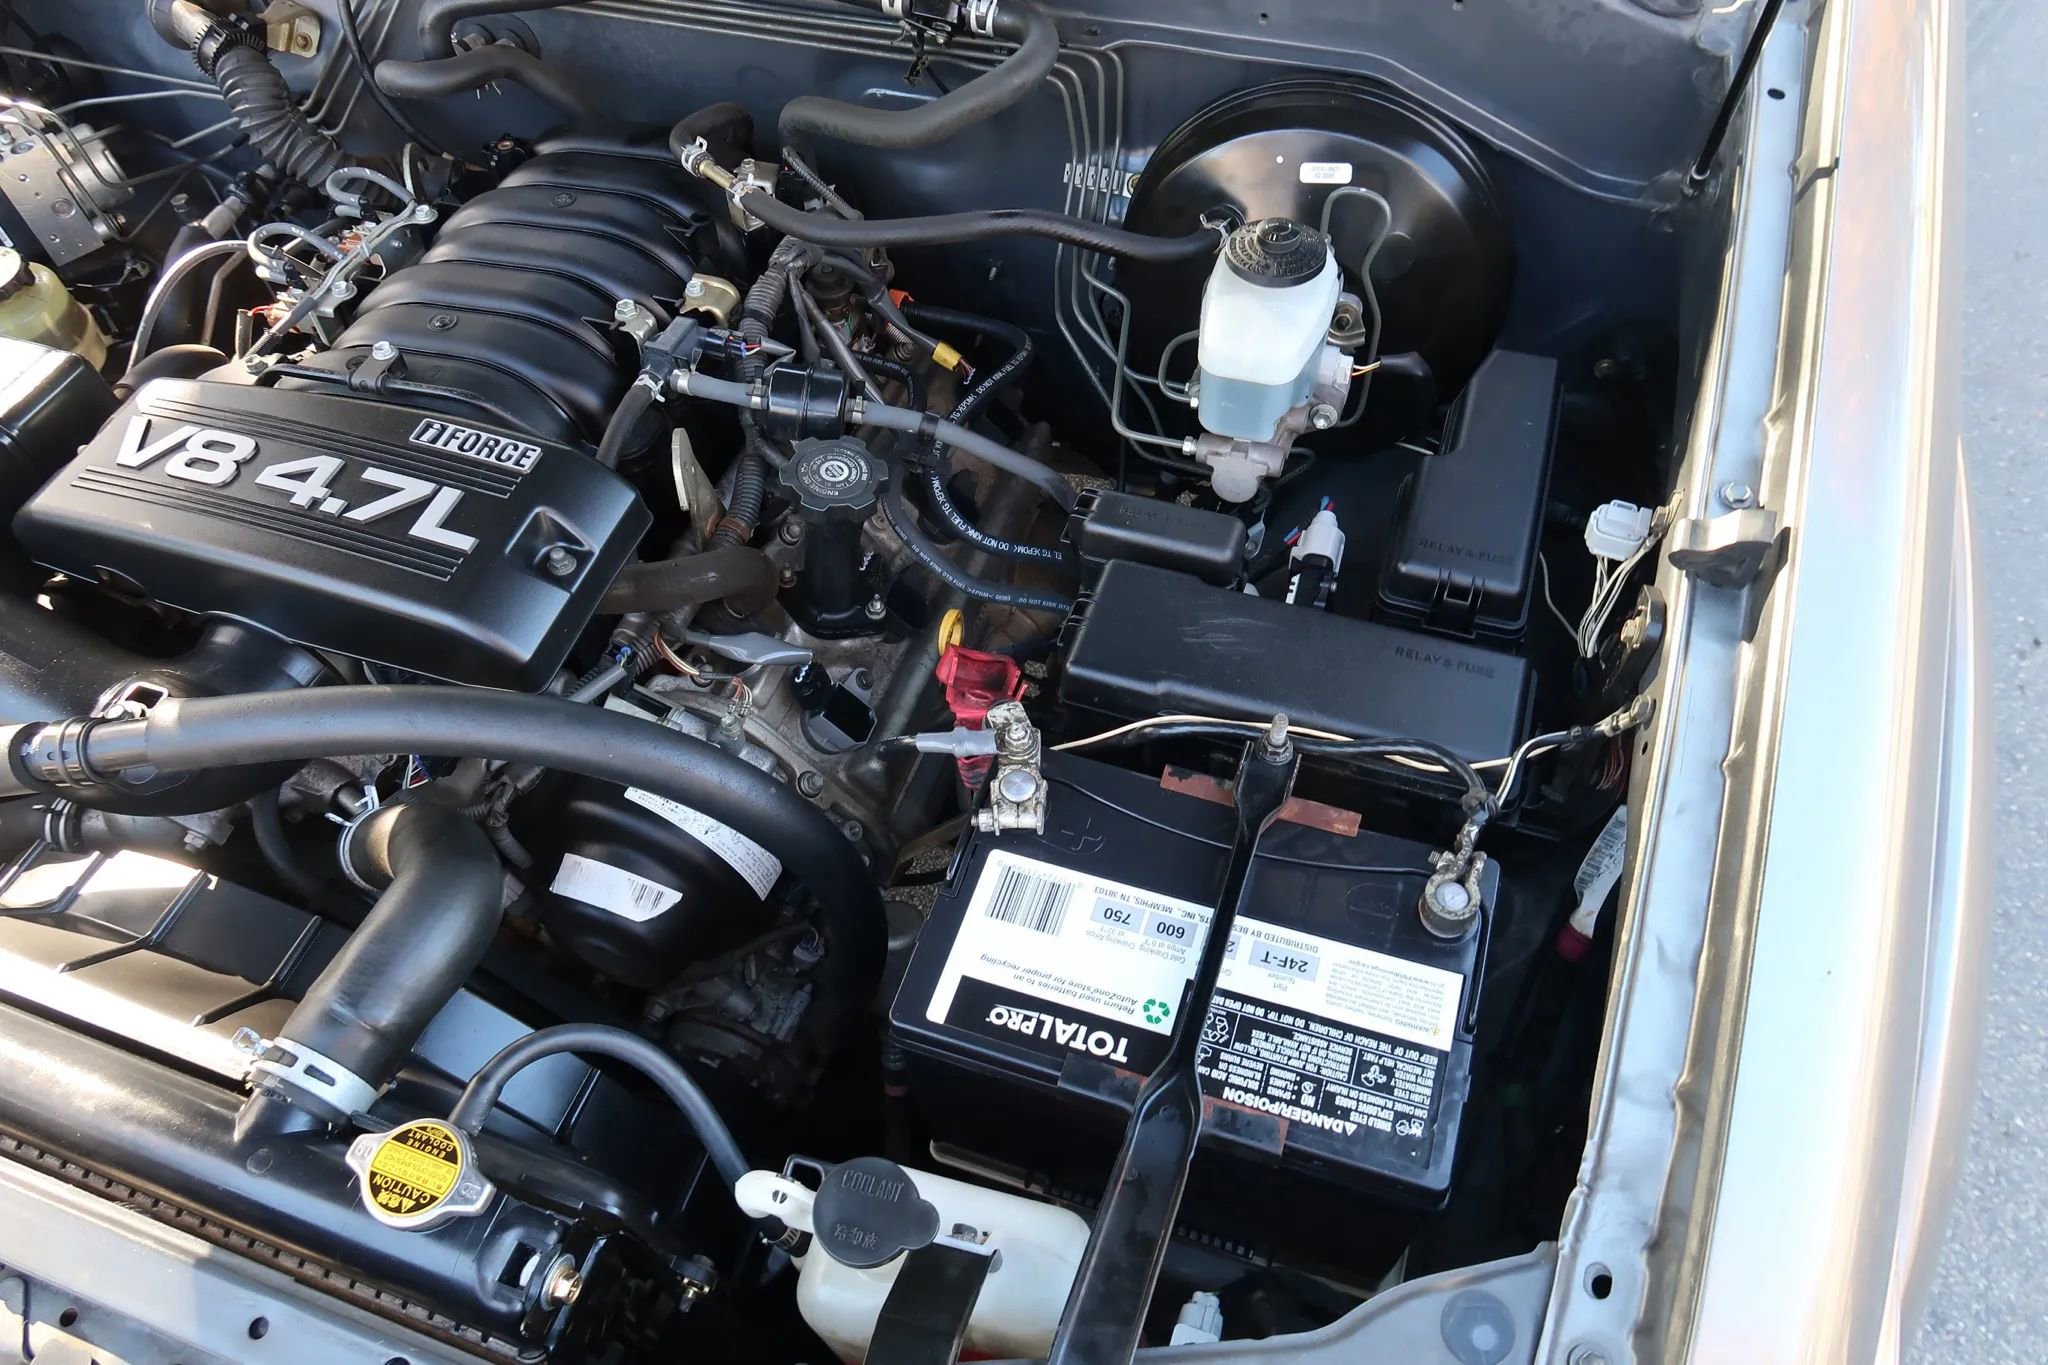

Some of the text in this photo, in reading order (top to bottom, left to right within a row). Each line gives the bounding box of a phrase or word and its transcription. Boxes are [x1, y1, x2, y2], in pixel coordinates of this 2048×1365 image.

[975, 383, 986, 395] DO
[982, 377, 994, 389] NOT
[1001, 361, 1014, 374] FUEL
[116, 415, 480, 554] V8 4.7L
[941, 503, 951, 516] TG
[950, 514, 965, 531] FUEL
[982, 536, 998, 549] NOT
[999, 541, 1009, 550] DO
[1041, 549, 1052, 558] TG
[911, 544, 920, 553] DO
[919, 551, 930, 563] NOT
[929, 561, 943, 574] KINK
[953, 578, 966, 589] FUEL
[1394, 646, 1496, 679] RELAY & FUSE
[1093, 885, 1118, 898] 38103
[1119, 892, 1131, 902] TN
[1131, 894, 1173, 914] MEMPHIS,
[1102, 906, 1132, 925] 750
[1084, 928, 1136, 949] Cranking Amps
[1155, 919, 1186, 939] 600
[1231, 923, 1319, 954] DISTRIBUTED BY BES
[1137, 942, 1186, 964] Cold Cranking
[1157, 941, 1165, 949] at
[1165, 942, 1186, 955] Amps
[979, 952, 1021, 972] recycling
[1259, 949, 1309, 973] 24F-T
[1020, 964, 1052, 981] proper
[1052, 975, 1066, 985] for
[1012, 973, 1135, 1015] Return used batteries to an
[1067, 979, 1091, 993] store
[1211, 994, 1438, 1065] KEEP OUT OF THE REACH OF CHILDREN. DO NOT TIP. DO NOT OPEN BAT
[1250, 1028, 1266, 1039] SEEK
[1275, 1044, 1300, 1057] VEHICLE
[1290, 1030, 1353, 1056] SERVICE ASSISTANCE.
[1297, 1042, 1311, 1053] NOT
[1310, 1045, 1318, 1054] IF
[1219, 1050, 1264, 1071] SEVERE BURNS
[1232, 1040, 1348, 1081] CAUTION: FOR JUMP STARTING, FOLLOW
[1299, 1050, 1308, 1060] IN
[1306, 1053, 1350, 1072] INSTRUCTIONS
[1360, 1050, 1435, 1078] GET MEDICAL HELP FAST.
[1196, 1064, 1259, 1090] SULFURIC ACID CAN
[1217, 1060, 1262, 1080] BLINDNESS OR
[1268, 1066, 1296, 1081] SMOKING
[1391, 1068, 1433, 1087] WITH WATER.
[1266, 1084, 1291, 1099] SPARKS
[1268, 1076, 1293, 1090] FLAMES
[1389, 1077, 1433, 1096] IMMEDIATELY
[1299, 1092, 1316, 1107] NO
[1325, 1081, 1428, 1118] CAN CAUSE BLINDNESS OR INJURY
[1392, 1087, 1431, 1105] FLUSH EYES
[1221, 1085, 1346, 1133] DANGER/POISON
[1334, 1094, 1394, 1120] EXPLOSIVE GASES
[1348, 1110, 1392, 1131] SHIELD EYES
[405, 1137, 446, 1158] ENGINE
[407, 1128, 454, 1152] COOLANT
[370, 1172, 432, 1205] CAUTION
[841, 1169, 905, 1203] COOLANT
